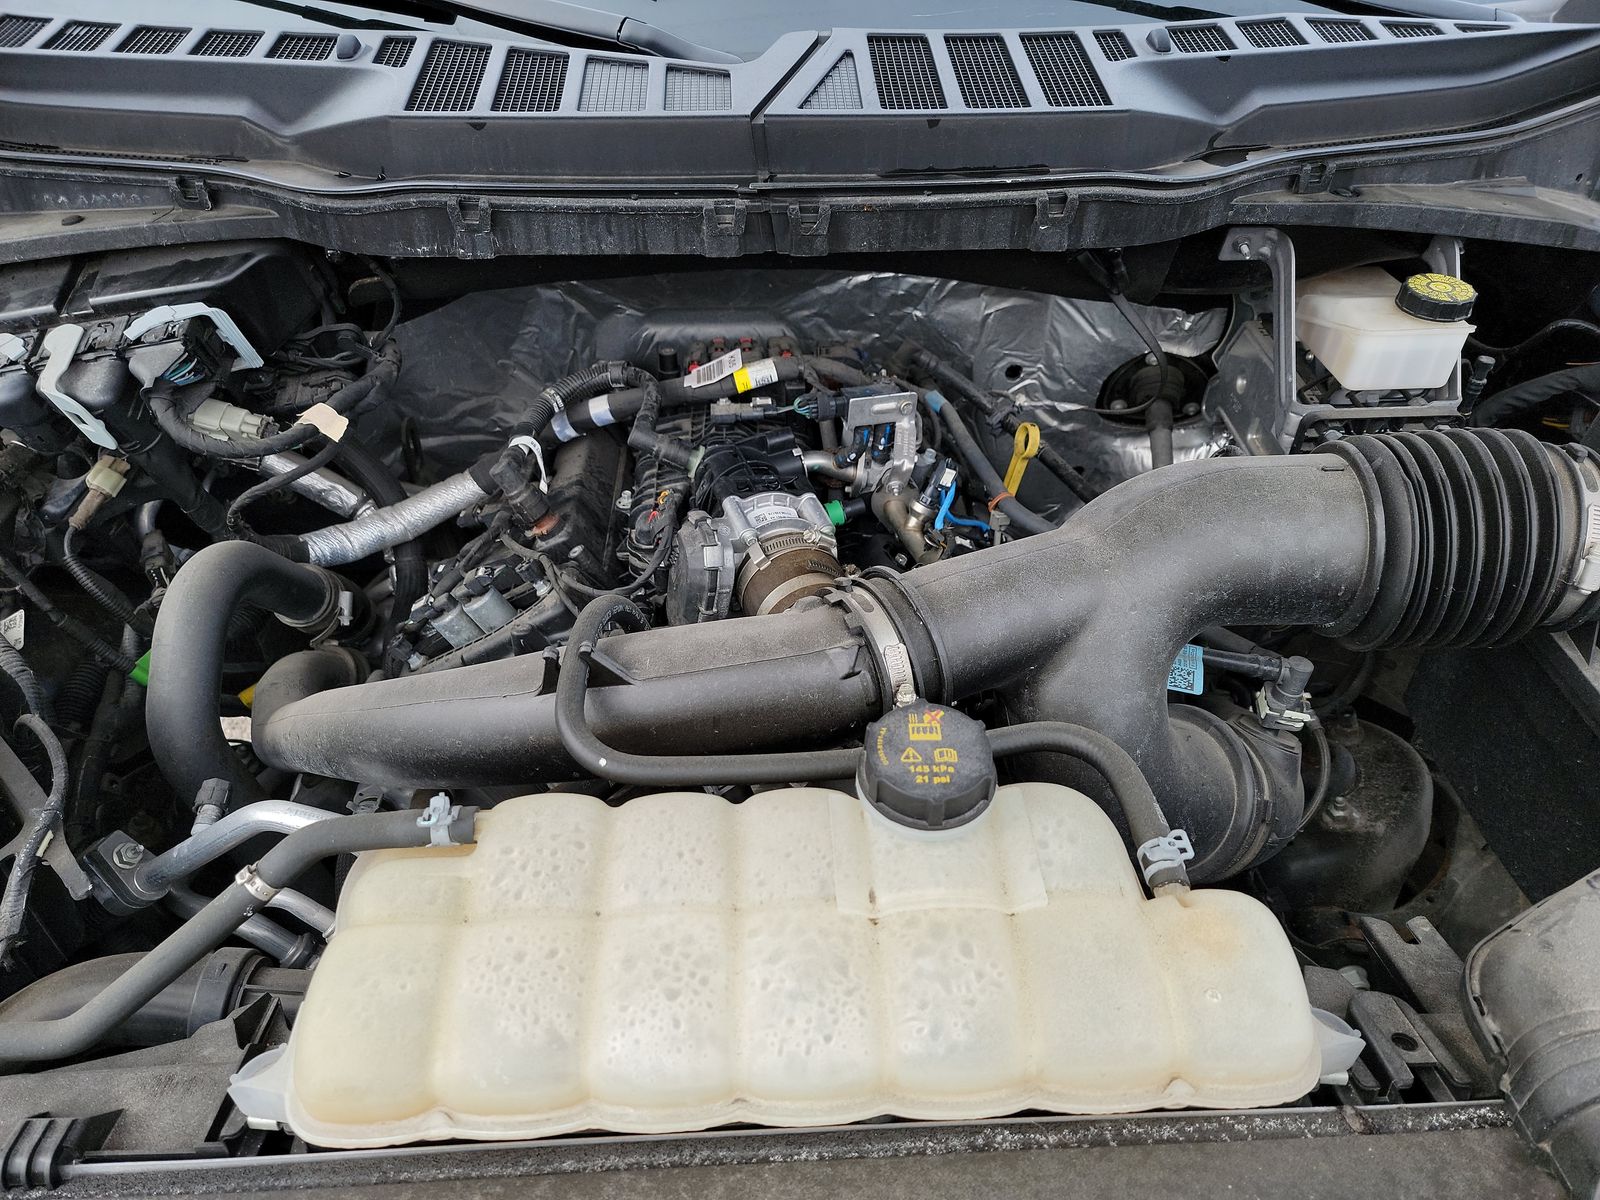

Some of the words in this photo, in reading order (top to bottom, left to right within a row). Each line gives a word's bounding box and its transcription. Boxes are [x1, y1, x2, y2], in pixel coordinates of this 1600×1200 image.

[933, 765, 955, 773] kPa
[915, 775, 929, 784] 21
[933, 775, 950, 785] psi
